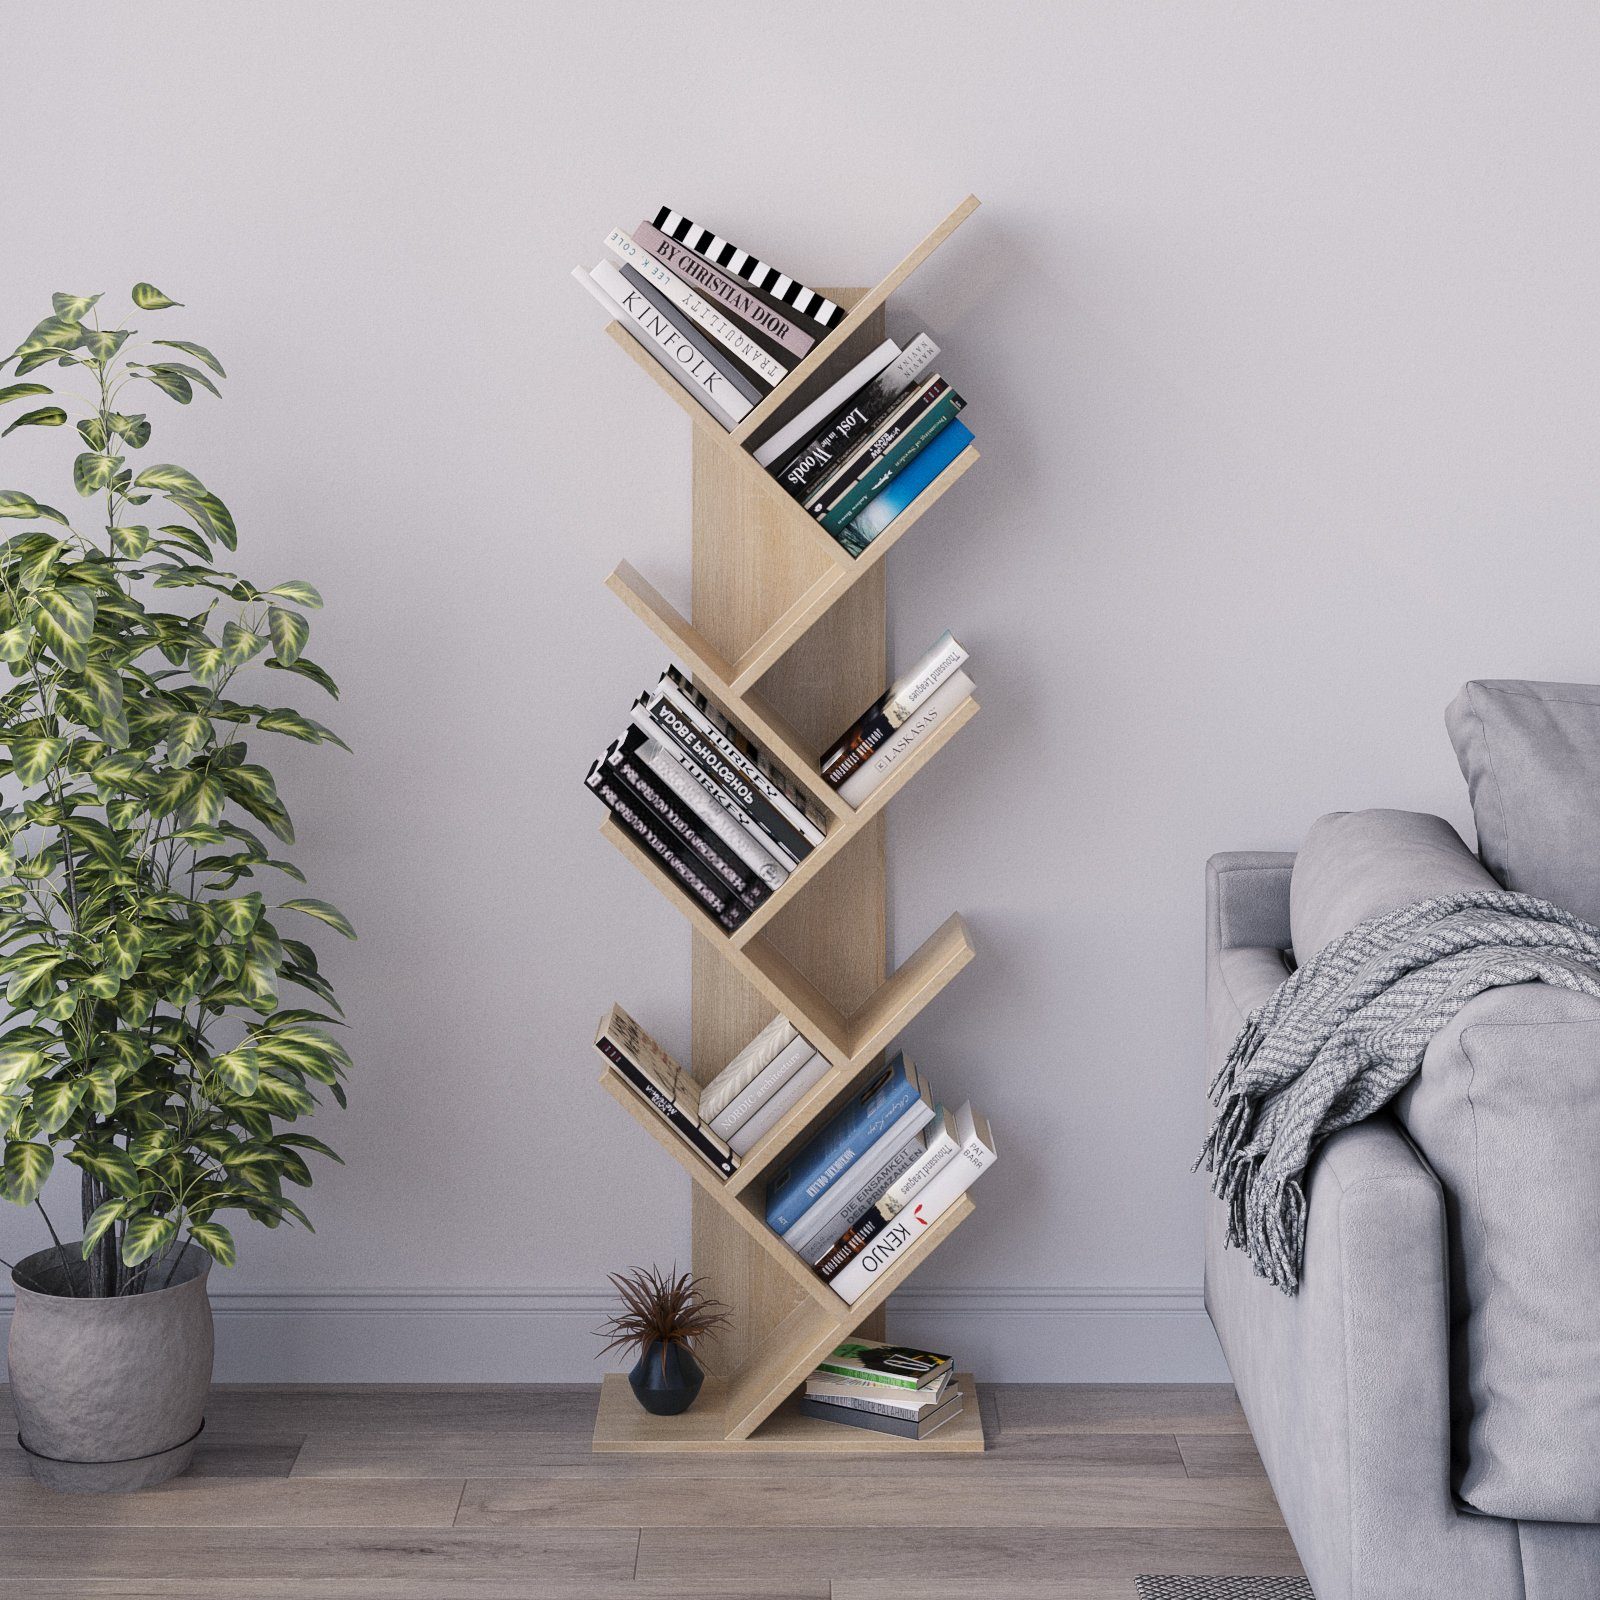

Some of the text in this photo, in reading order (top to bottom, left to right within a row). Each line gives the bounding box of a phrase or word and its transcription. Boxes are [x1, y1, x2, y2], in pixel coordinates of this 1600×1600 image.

[609, 231, 636, 256] COLE
[650, 266, 670, 285] LEE
[656, 241, 790, 340] BY CHRISTIAN DIOR
[621, 289, 723, 393] KINFOLK
[681, 291, 779, 377] TRANQUILITY
[902, 346, 934, 378] MARVIN
[828, 430, 837, 440] in
[834, 406, 868, 439] Lost
[918, 415, 947, 442] Dreaming
[819, 436, 832, 449] the
[893, 445, 916, 467] Sweden
[914, 439, 922, 448] of
[786, 445, 831, 488] Woods
[929, 650, 960, 681] Thousand
[906, 675, 933, 702] Leagues
[855, 727, 883, 757] JONATHAN
[884, 708, 939, 762] LASKASAS
[720, 1093, 757, 1130] NORDIC
[754, 1050, 801, 1097] architecture
[921, 1143, 952, 1174] Thousand
[962, 1148, 983, 1169] BARR
[969, 1142, 983, 1157] PAT
[839, 1148, 910, 1218] DIE EINSAMKEIT
[845, 1148, 923, 1225] DER PRIMZAHLEN
[900, 1169, 926, 1196] Leagues
[847, 1220, 875, 1250] JONATHAN
[859, 1222, 911, 1274] KENJO
